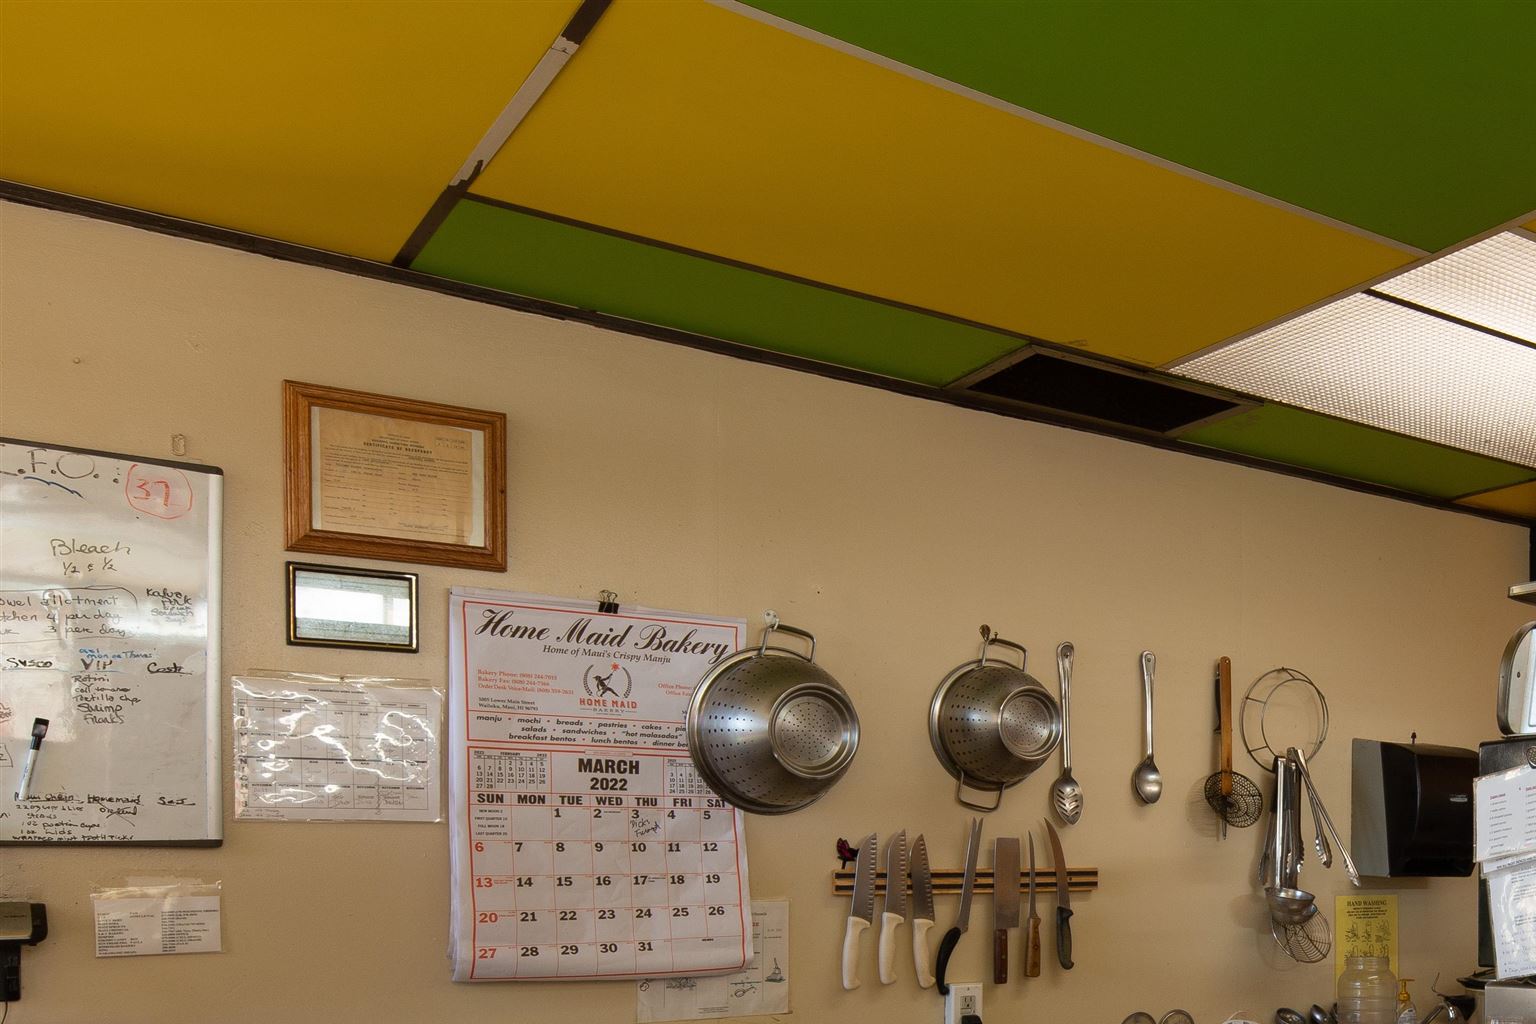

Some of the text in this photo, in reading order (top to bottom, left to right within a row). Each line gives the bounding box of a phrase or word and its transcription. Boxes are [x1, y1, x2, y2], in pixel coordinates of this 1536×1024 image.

[133, 478, 171, 507] 37
[50, 538, 131, 556] Bleach
[63, 557, 117, 575] 1/2 1/2
[0, 596, 31, 607] owel
[0, 611, 38, 621] tchen
[475, 609, 729, 665] Home Maid Bakery
[543, 645, 671, 665] Home of Maui's Crispy Manju
[81, 658, 113, 670] VIP
[579, 698, 637, 709] HOME MAID
[562, 727, 607, 736] sandwiches
[598, 721, 627, 729] pastries
[509, 733, 547, 741] breakfast
[578, 758, 640, 775] MARCH
[590, 777, 628, 791] 2022
[477, 793, 726, 808] SUN MON TUE WED THU FRI SAT
[554, 808, 711, 819] 1 2 3 4 5
[475, 842, 718, 852] 6 7 8 9 10 11 12
[476, 874, 720, 888] 13 14 15 16 17 18 19
[479, 906, 725, 923] 20 21 22 23 24 25 26
[479, 942, 653, 959] 27 28 29 30 31
